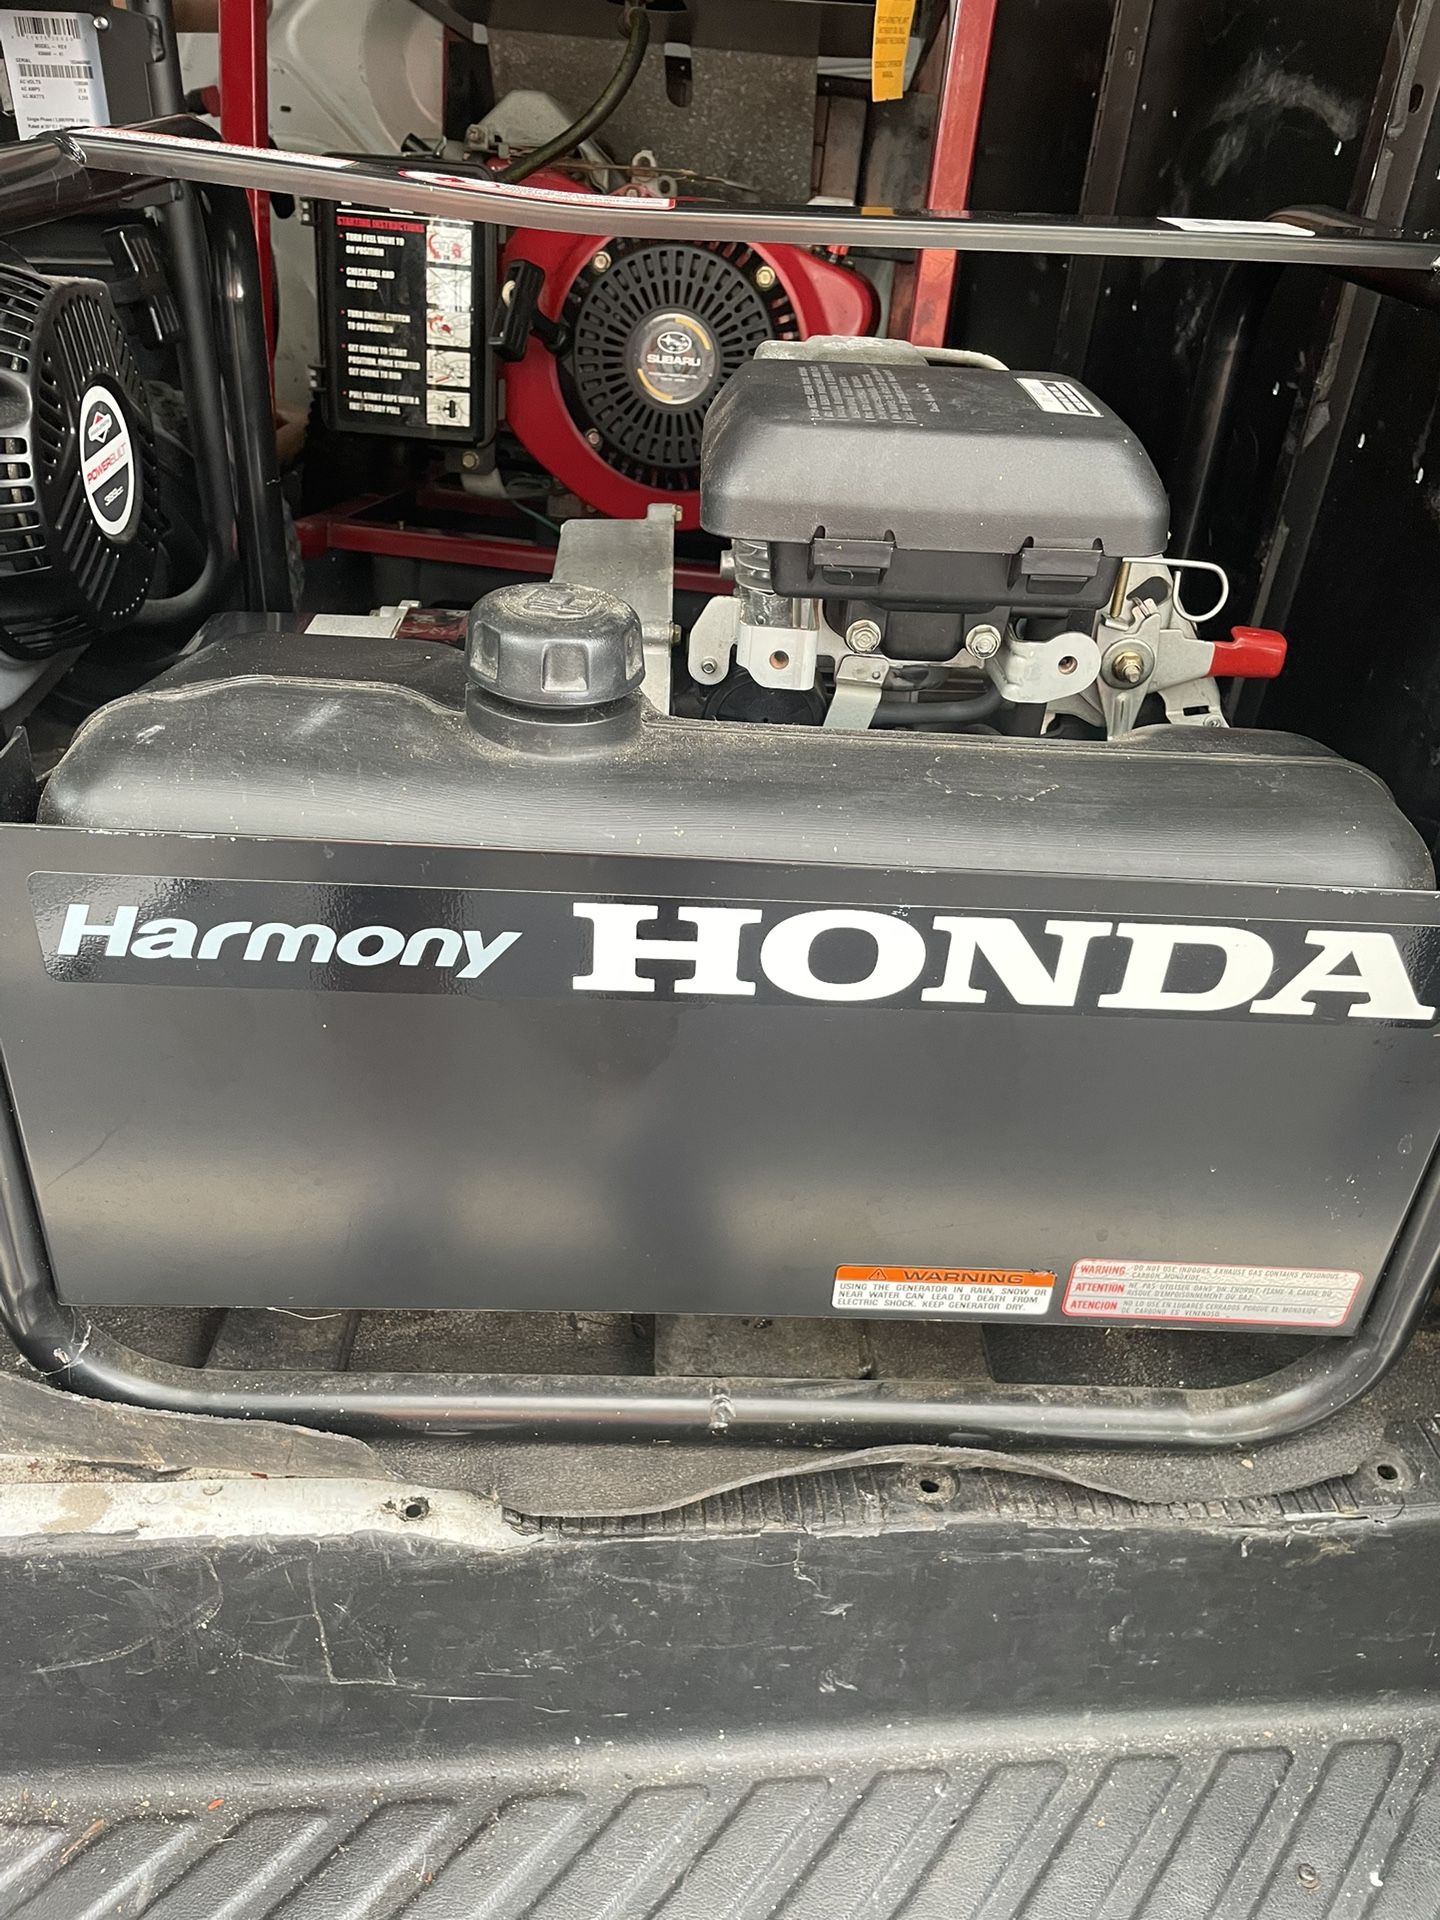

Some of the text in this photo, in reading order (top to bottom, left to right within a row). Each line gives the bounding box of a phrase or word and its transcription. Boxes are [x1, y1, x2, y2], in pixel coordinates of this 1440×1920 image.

[647, 354, 701, 367] SUBARU
[86, 442, 126, 485] POWERBUILT
[57, 903, 523, 979] Harmony
[571, 901, 1438, 1021] HONDA
[1080, 1265, 1126, 1275] WARNING
[1265, 1270, 1298, 1278] CONTAINS
[903, 1270, 1025, 1284] WARNING
[840, 1283, 867, 1291] USING
[895, 1284, 948, 1293] GENERATOR
[1001, 1287, 1030, 1295] SNOW
[1075, 1282, 1125, 1293] ATTENTION
[868, 1291, 900, 1299] WATER
[976, 1294, 1006, 1302] DEATH
[837, 1298, 879, 1306] ELECTRIC
[921, 1300, 945, 1308] KEEP
[948, 1301, 1001, 1310] GENERATOR
[1071, 1300, 1118, 1310] ATENCION
